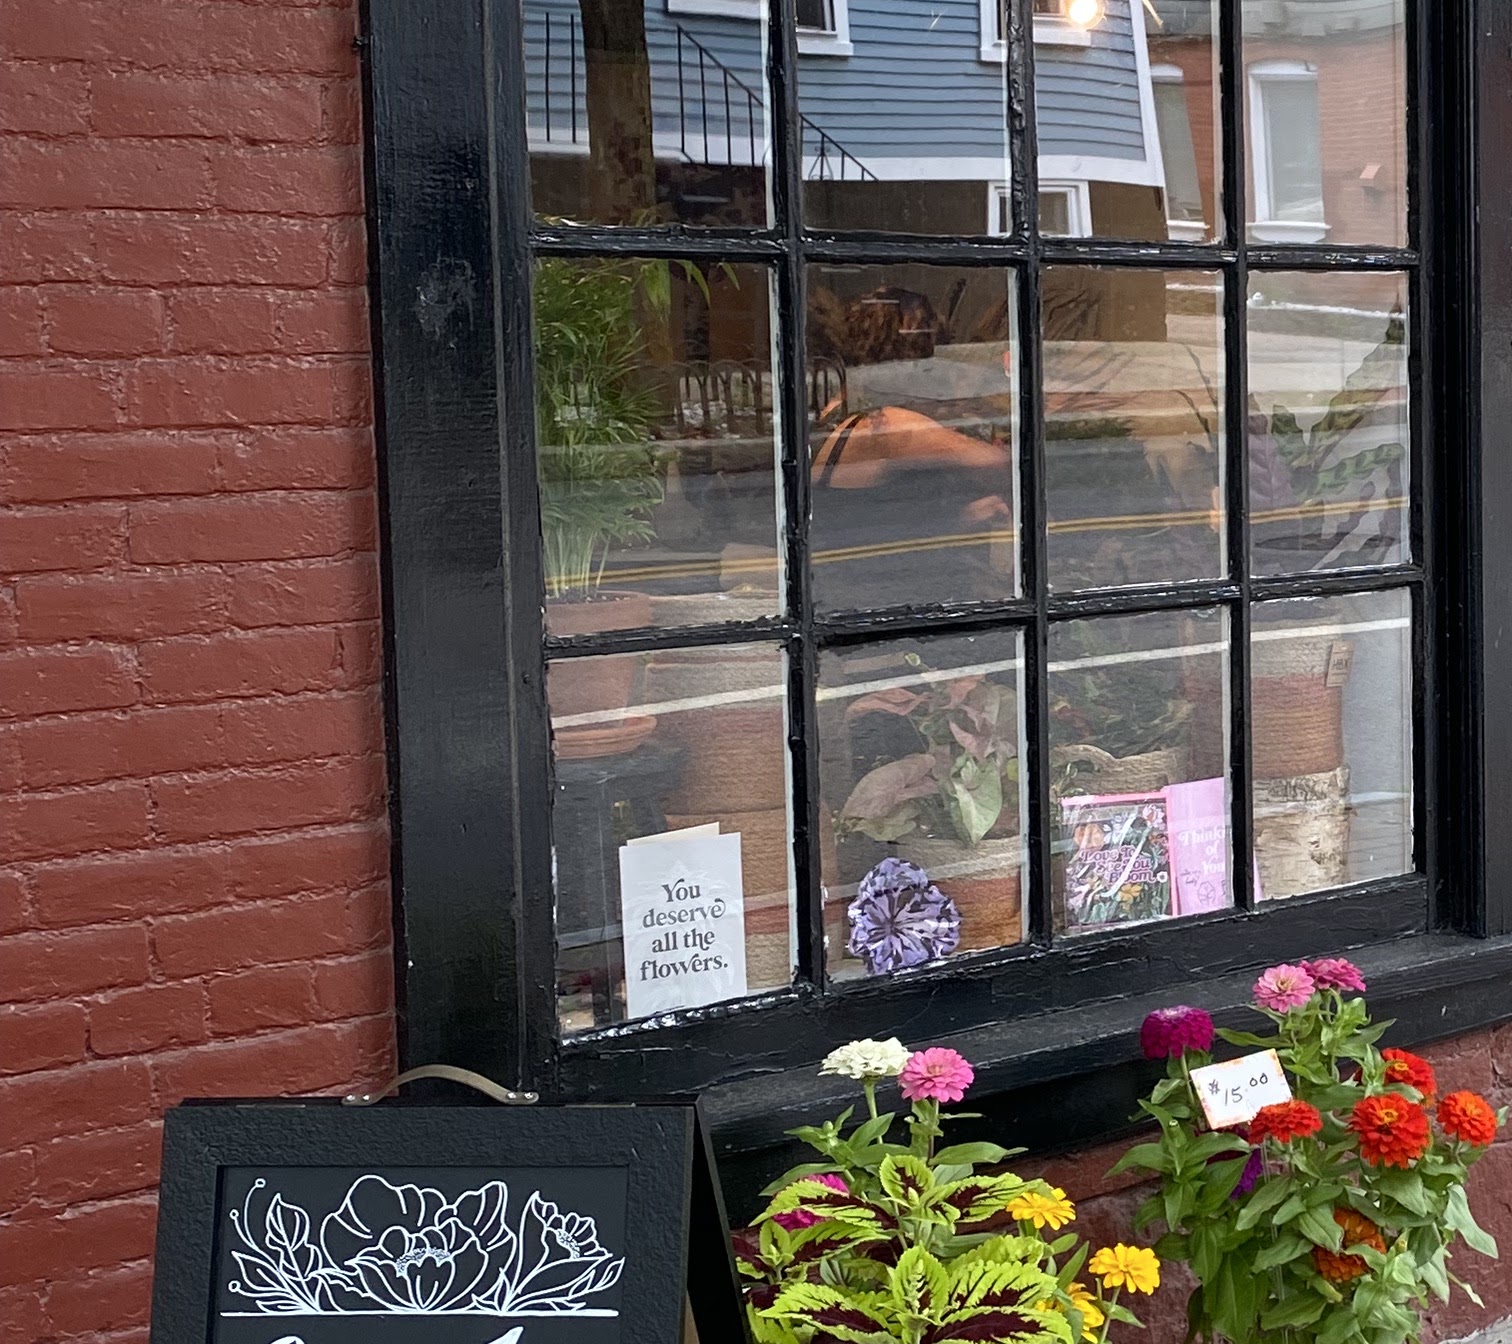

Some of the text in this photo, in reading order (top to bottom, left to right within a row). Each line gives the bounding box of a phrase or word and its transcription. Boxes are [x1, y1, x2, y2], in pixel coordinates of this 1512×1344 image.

[662, 878, 701, 903] You
[642, 898, 726, 928] deserve
[651, 928, 715, 953] all the
[640, 953, 728, 981] flowers.
